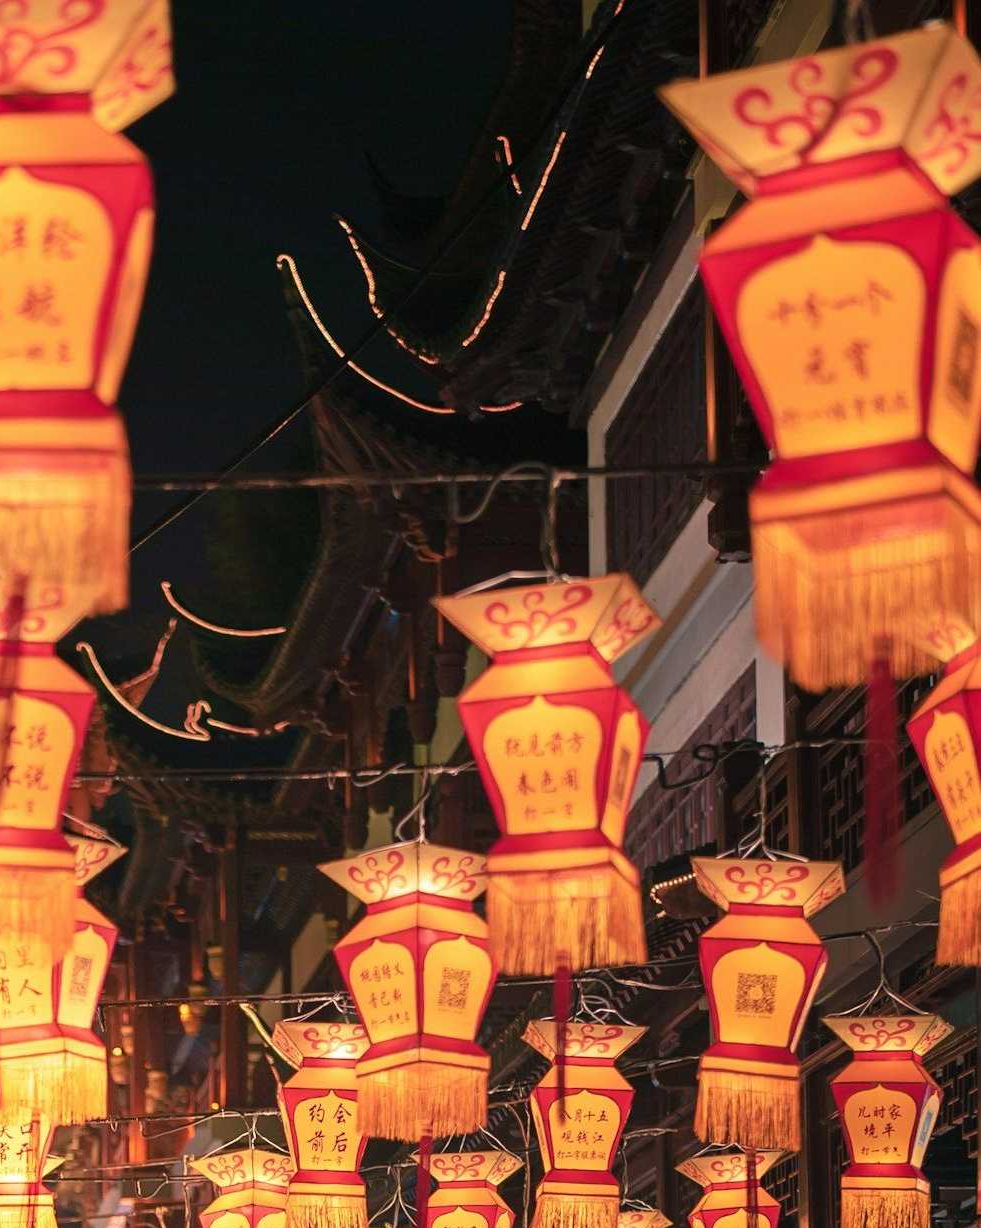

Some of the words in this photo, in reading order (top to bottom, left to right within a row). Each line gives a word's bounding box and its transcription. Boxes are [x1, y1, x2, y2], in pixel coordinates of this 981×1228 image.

[858, 1104, 903, 1120] 儿时家
[306, 1130, 348, 1153] 前后
